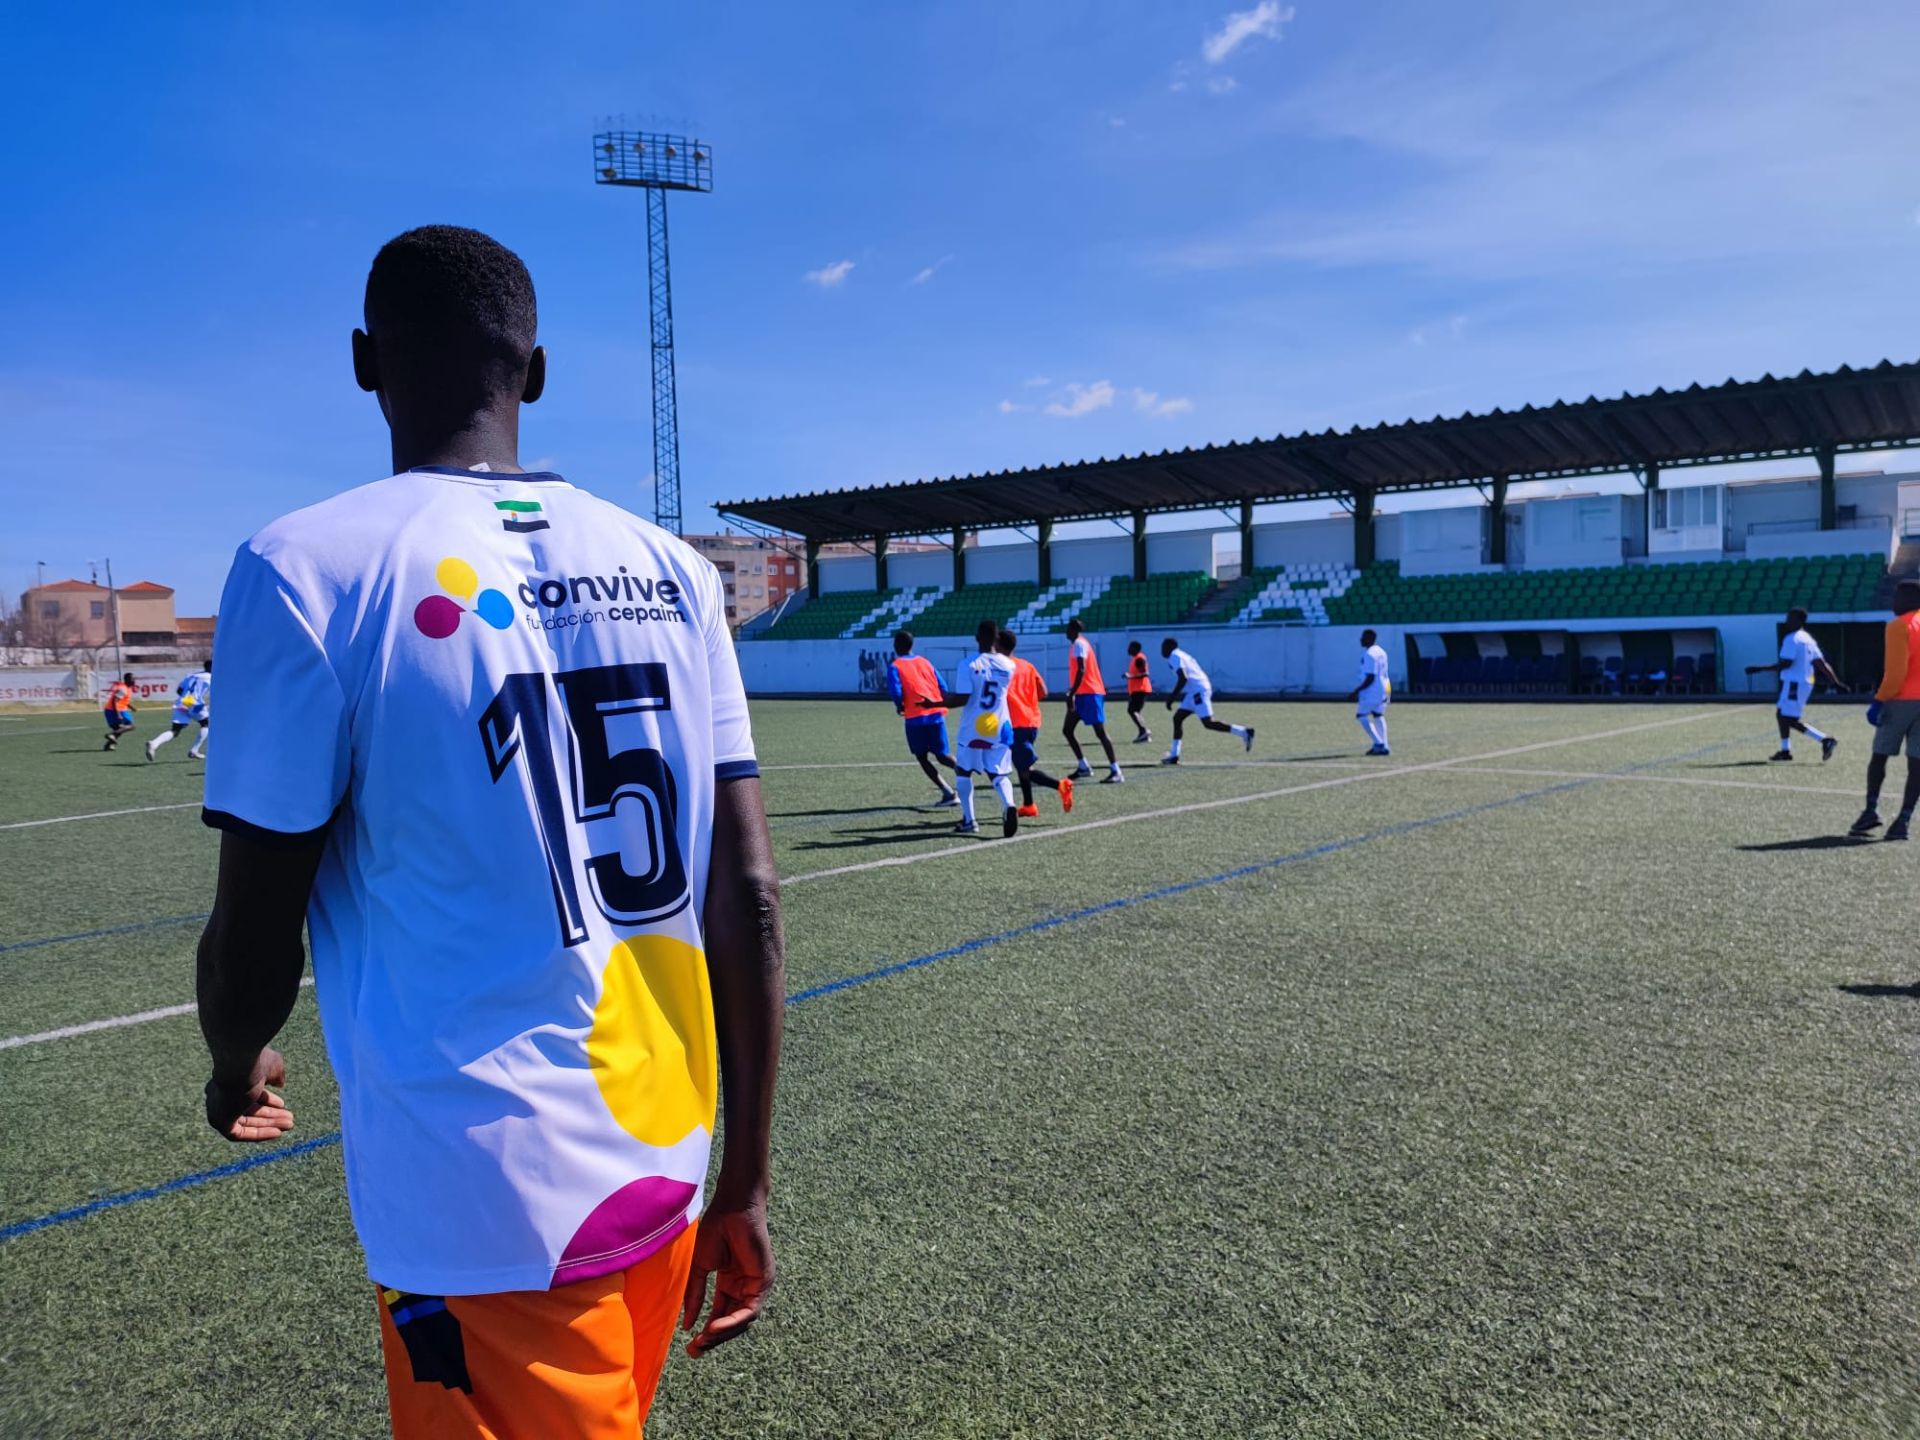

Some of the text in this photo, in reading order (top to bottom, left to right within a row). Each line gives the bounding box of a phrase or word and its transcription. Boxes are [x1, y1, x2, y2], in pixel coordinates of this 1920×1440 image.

[517, 565, 681, 609] convive
[608, 604, 687, 626] cepaim
[18, 684, 75, 699] PIÑERO
[980, 681, 999, 710] 5
[478, 662, 691, 949] 15
